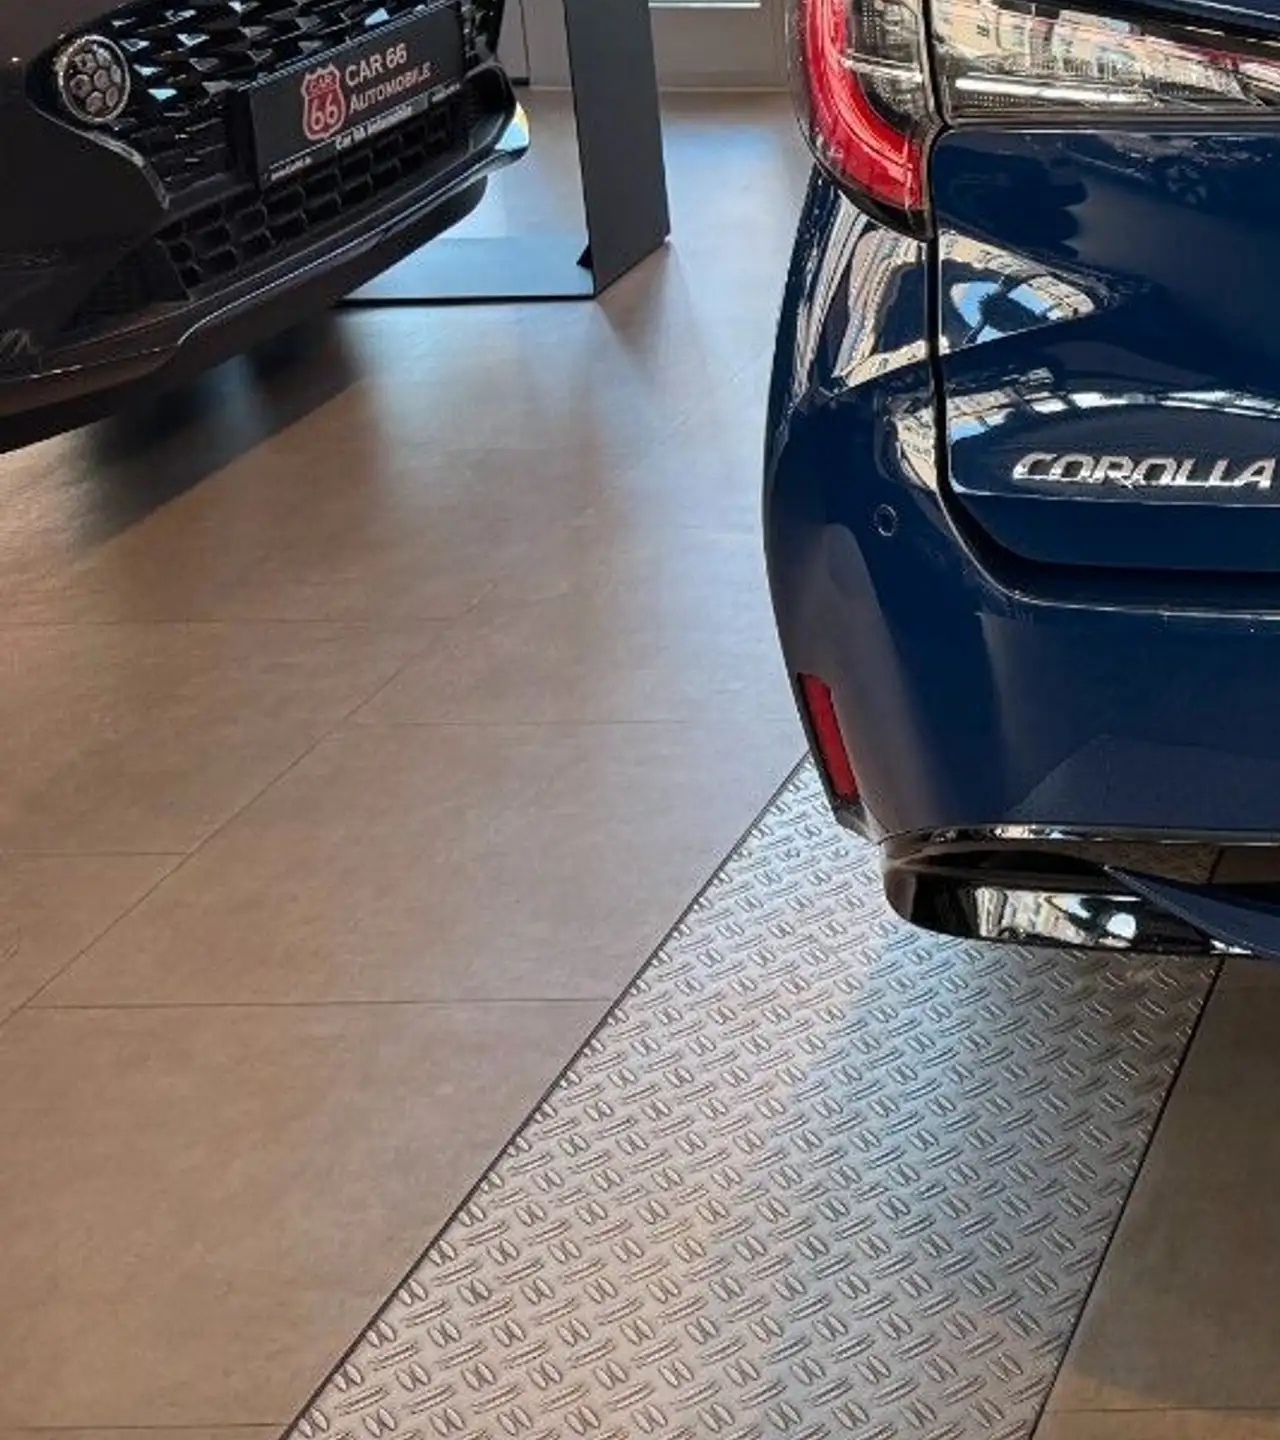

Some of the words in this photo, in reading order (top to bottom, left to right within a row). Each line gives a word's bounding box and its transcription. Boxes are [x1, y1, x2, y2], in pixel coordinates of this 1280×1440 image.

[345, 55, 382, 87] CAR
[385, 42, 408, 68] 66
[310, 95, 339, 131] 66
[1012, 451, 1277, 490] COROLLA
